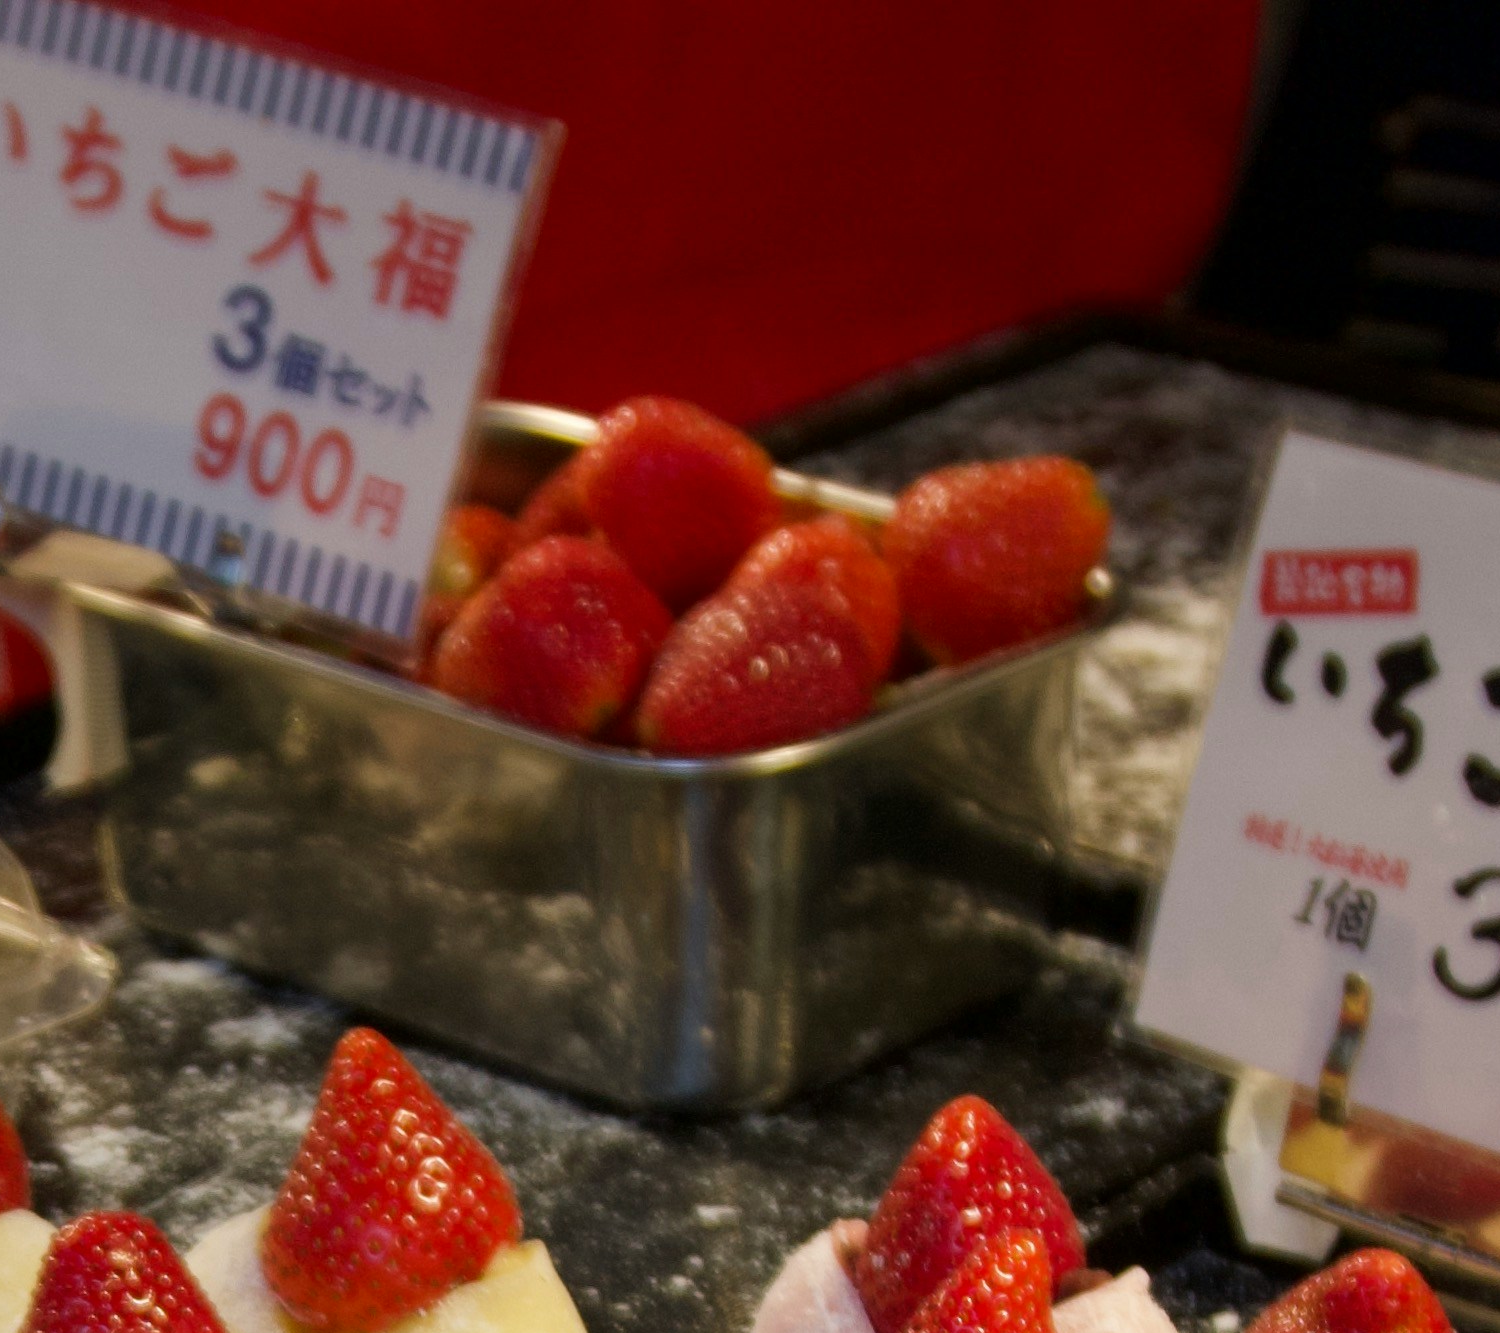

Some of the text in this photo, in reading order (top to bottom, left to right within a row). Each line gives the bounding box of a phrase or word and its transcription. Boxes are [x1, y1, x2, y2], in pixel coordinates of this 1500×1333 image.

[212, 286, 434, 429] 3個セット
[195, 393, 408, 540] 900円
